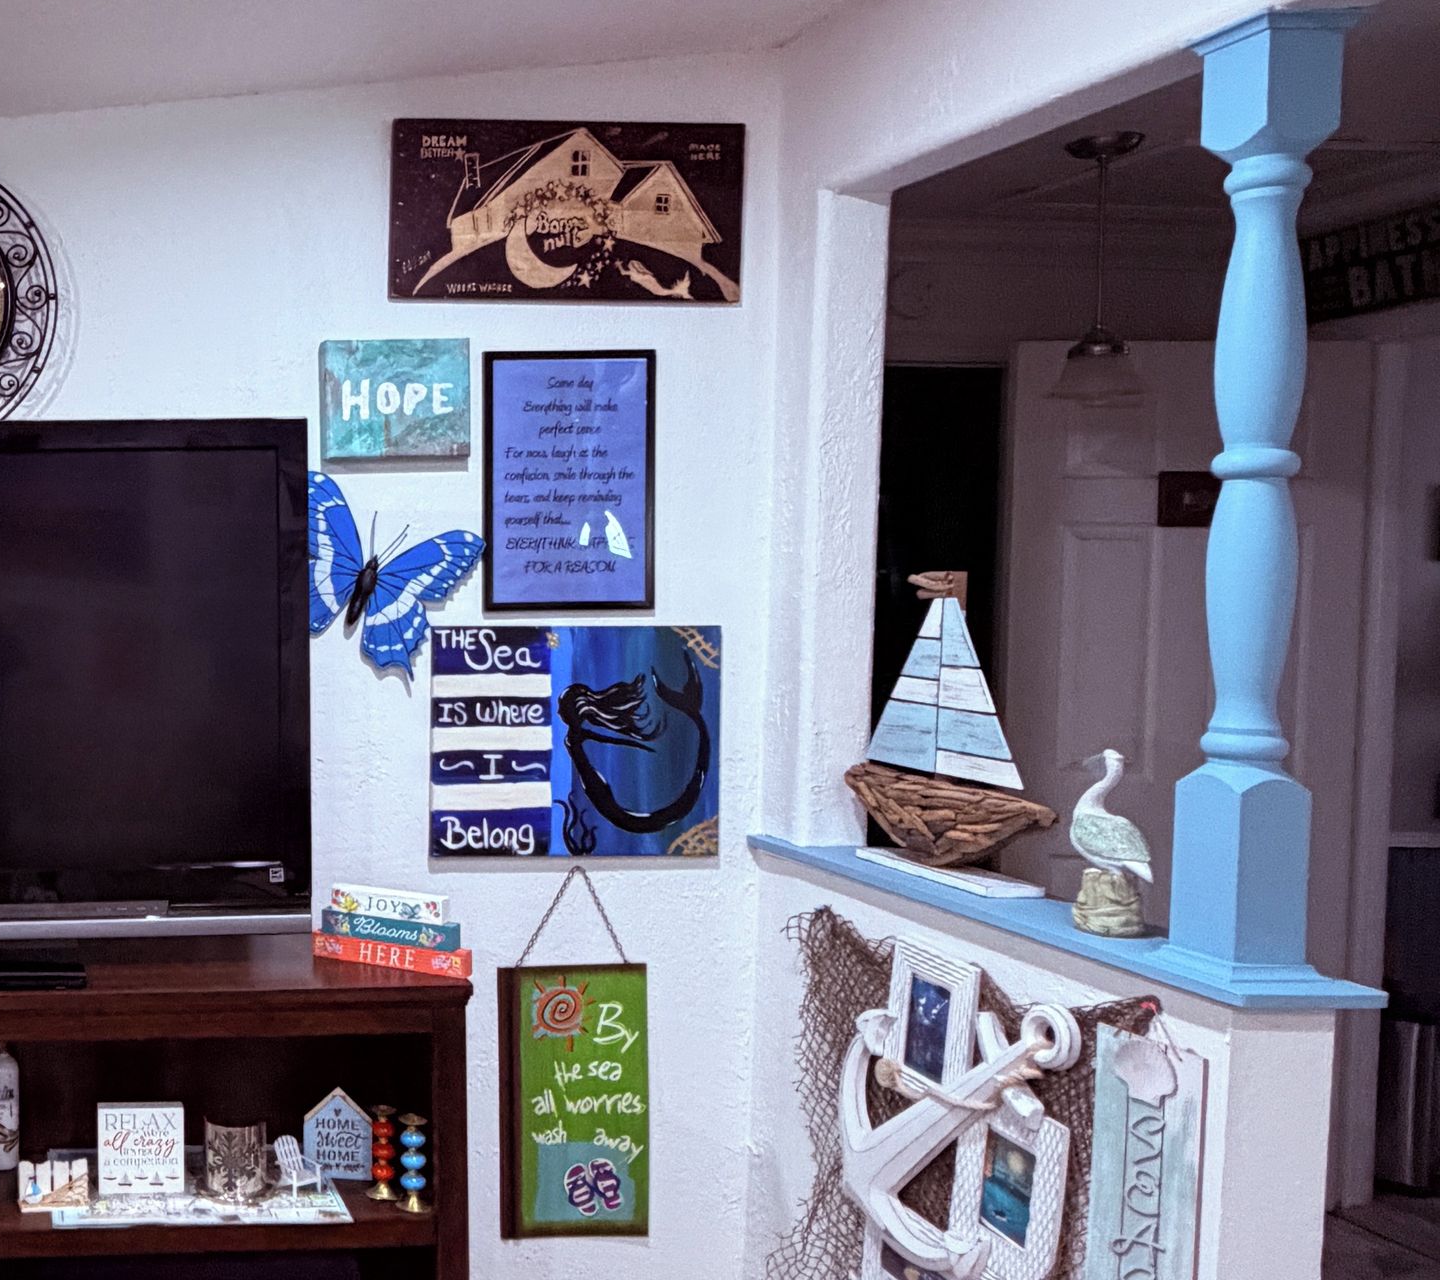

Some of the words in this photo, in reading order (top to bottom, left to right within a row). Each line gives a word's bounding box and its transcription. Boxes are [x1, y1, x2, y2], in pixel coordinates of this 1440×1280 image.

[422, 135, 467, 148] DREAM
[341, 378, 454, 422] HOPE
[523, 399, 572, 416] Everything
[575, 399, 592, 412] will
[539, 421, 574, 438] perfect
[505, 447, 524, 459] For
[591, 445, 608, 458] the
[579, 467, 616, 484] through
[618, 467, 634, 480] the
[533, 489, 552, 502] and
[552, 489, 576, 507] keep
[578, 489, 622, 506] reminding
[504, 511, 542, 528] yourself
[435, 629, 477, 651] THE
[464, 628, 542, 671] Sea
[438, 701, 467, 726] IS
[478, 753, 505, 781] I
[440, 816, 536, 856] Belong
[365, 896, 402, 912] JOY
[353, 916, 418, 941] Blooms
[359, 942, 417, 970] HERE
[593, 1000, 639, 1053] By
[554, 1060, 583, 1091] the
[587, 1060, 622, 1081] sea
[532, 1089, 558, 1118] all
[563, 1091, 644, 1115] worries
[105, 1113, 177, 1130] RELAX
[315, 1118, 360, 1131] HOME
[104, 1130, 131, 1157] all
[133, 1135, 176, 1158] crazy
[532, 1120, 567, 1146] wash
[593, 1128, 644, 1164] away
[316, 1149, 360, 1162] HOME
